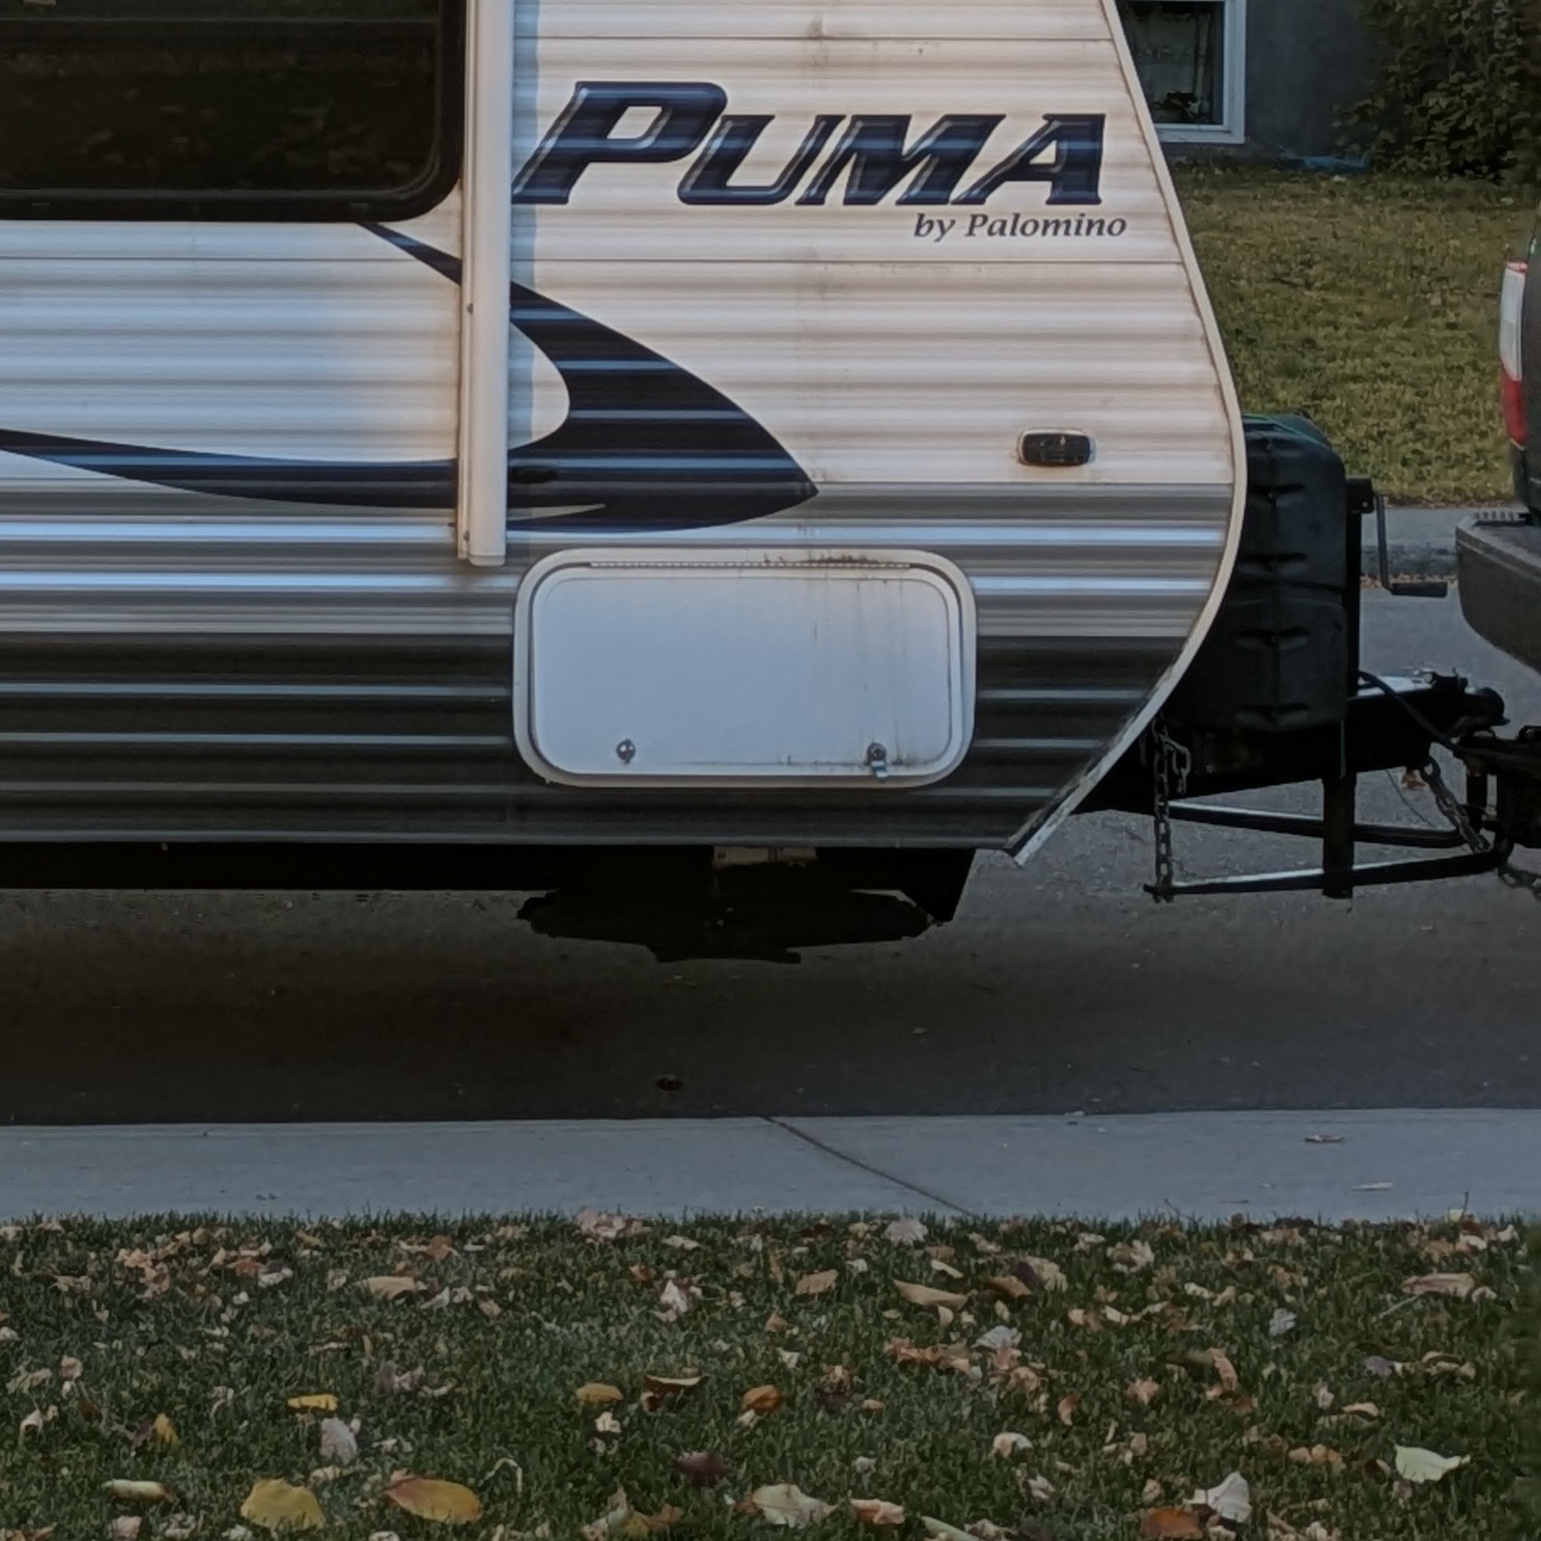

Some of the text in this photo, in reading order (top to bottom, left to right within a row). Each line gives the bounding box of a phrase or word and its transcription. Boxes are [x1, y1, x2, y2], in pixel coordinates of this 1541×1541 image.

[511, 80, 1106, 206] PUMA
[914, 212, 1128, 243] by Palomino
